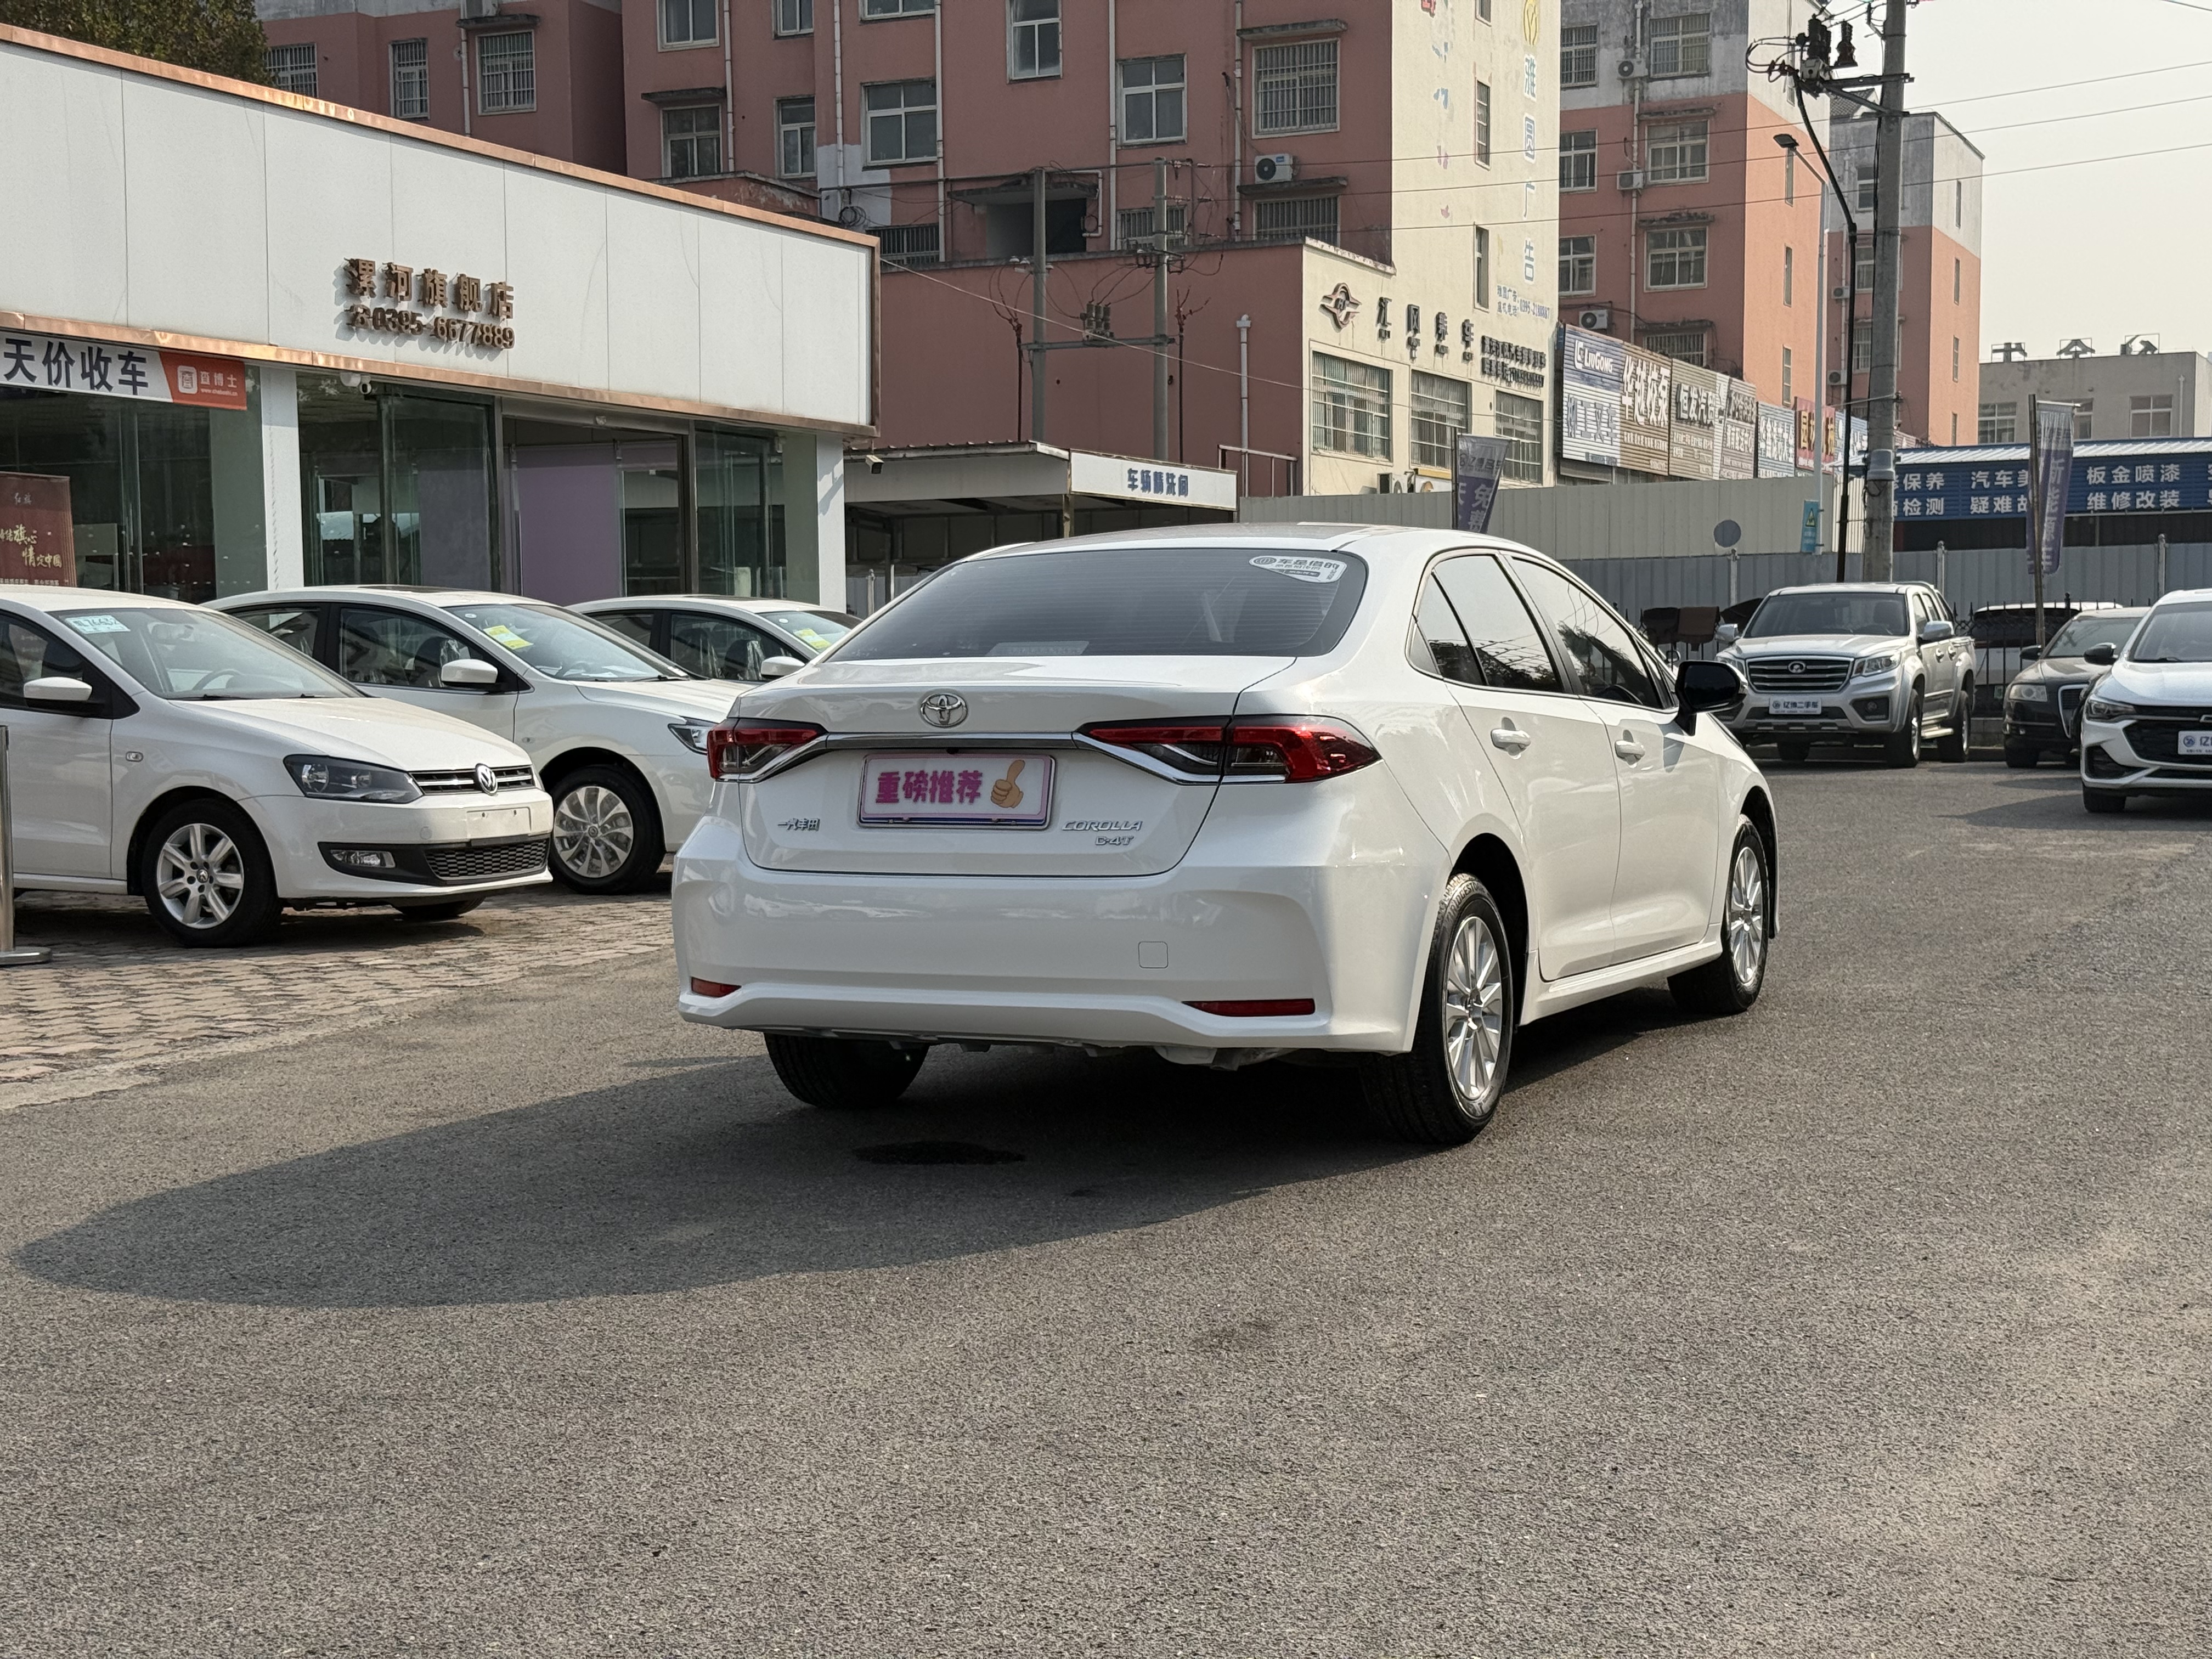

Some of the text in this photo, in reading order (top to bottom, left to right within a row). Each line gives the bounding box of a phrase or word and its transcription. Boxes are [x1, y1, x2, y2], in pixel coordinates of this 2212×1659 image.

[346, 258, 514, 319] 漯河旗舰店
[373, 307, 515, 349] 0395-6677889
[4, 338, 149, 396] 天价收车
[200, 371, 237, 388] 查博士
[2087, 464, 2180, 485] 板金喷漆
[2087, 489, 2180, 511] 维修改装
[22, 545, 62, 568] 情定中国
[2199, 736, 2212, 746] 亿
[876, 770, 983, 804] 重磅推荐
[777, 817, 820, 832] 一汽丰田
[1062, 821, 1143, 832] COROLLA
